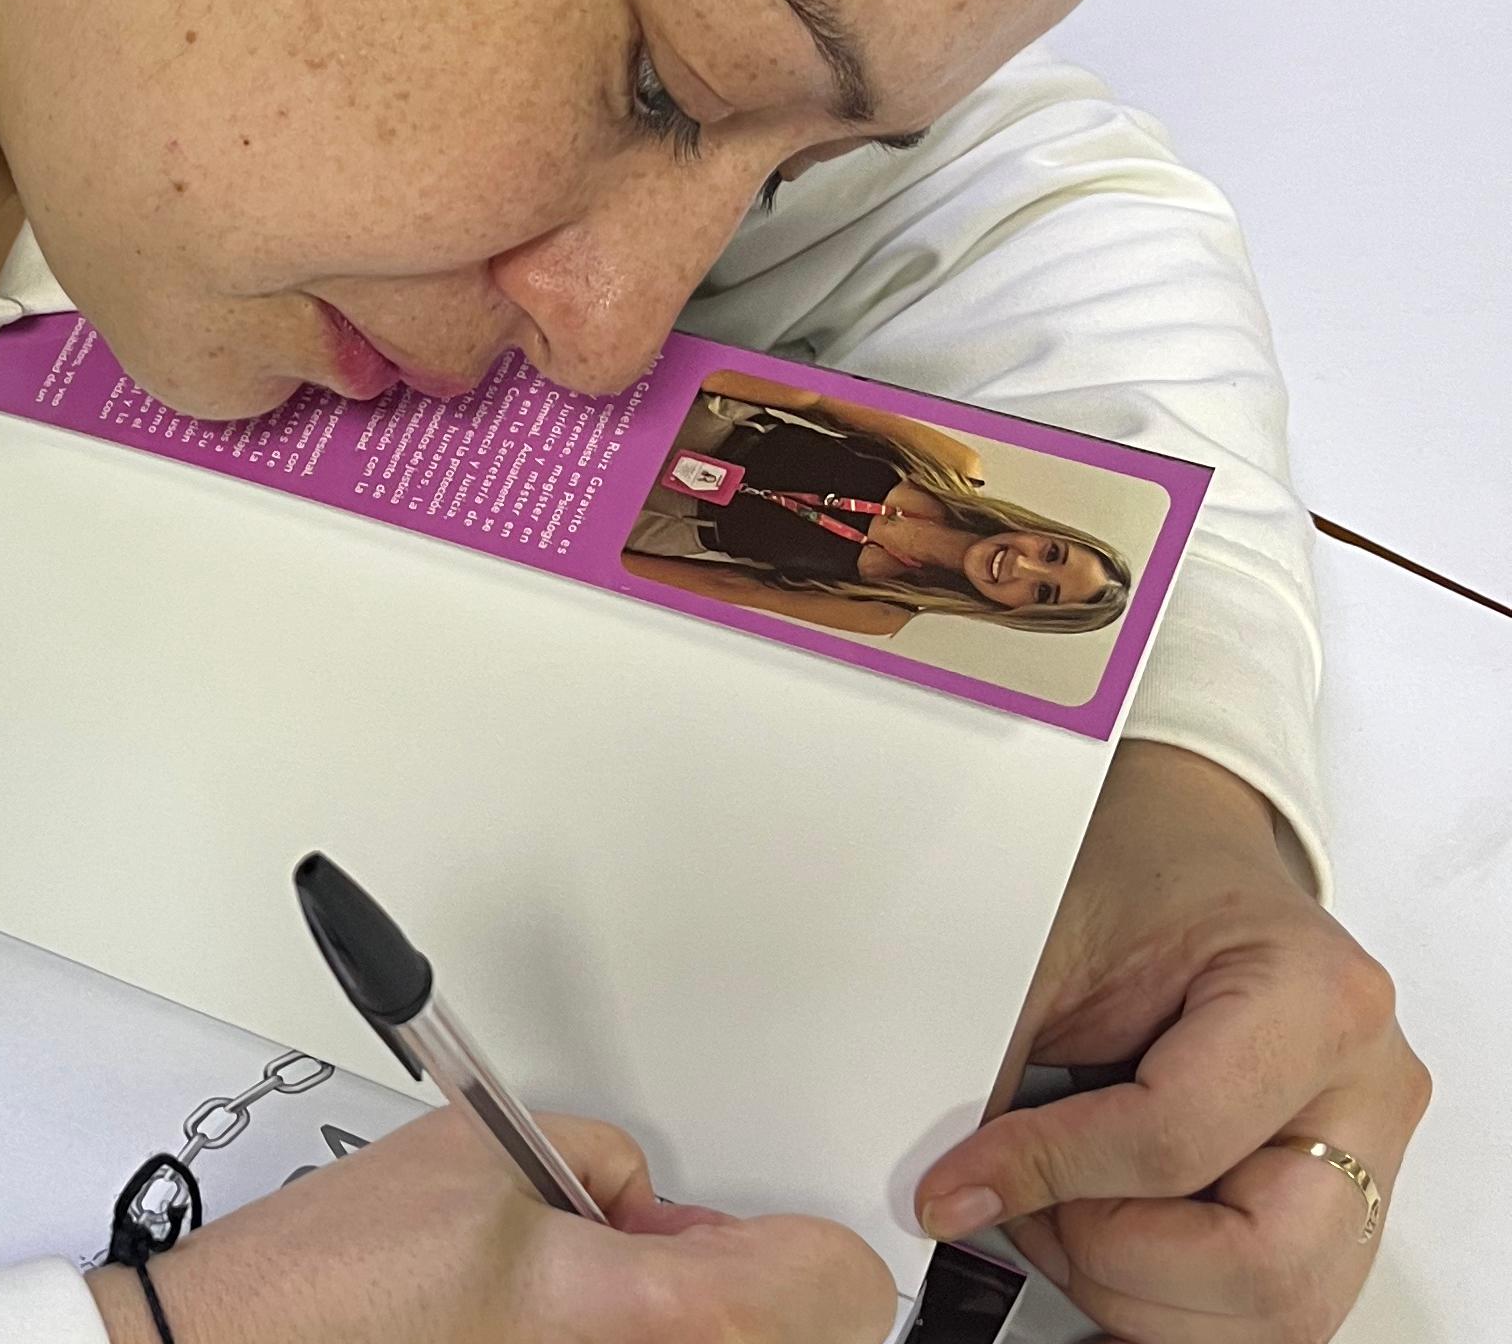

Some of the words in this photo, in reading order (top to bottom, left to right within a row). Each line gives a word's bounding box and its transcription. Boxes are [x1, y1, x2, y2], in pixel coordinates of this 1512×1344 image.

[52, 317, 87, 373] posibilidad
[43, 373, 57, 388] de
[63, 371, 75, 385] yo
[35, 388, 48, 402] un
[110, 377, 128, 399] vida
[485, 385, 499, 399] su
[51, 387, 67, 407] veo
[123, 399, 133, 408] y
[99, 399, 114, 420] con
[471, 400, 493, 430] labor
[518, 400, 532, 416] en
[614, 382, 650, 436] Gabriela
[115, 412, 129, 424] la
[131, 417, 142, 429] el
[148, 406, 167, 434] omo
[477, 387, 520, 455] Convivencia
[164, 418, 180, 438] uso
[296, 408, 323, 449] cercana
[417, 404, 446, 450] modelos
[509, 421, 525, 433] la
[578, 403, 615, 467] especialista
[198, 431, 214, 448] Su
[258, 431, 271, 446] en
[383, 398, 432, 479] fortalecimiento
[461, 429, 475, 445] en
[249, 450, 264, 462] la
[266, 450, 281, 468] de
[409, 450, 424, 466] de
[455, 445, 470, 457] la
[597, 441, 621, 470] Ruiz
[284, 452, 299, 473] con
[363, 456, 379, 477] con
[469, 461, 481, 469] y
[534, 457, 546, 466] y
[474, 439, 515, 504] Secretaría
[491, 443, 533, 513] Actualmente
[568, 472, 581, 487] en
[354, 481, 369, 494] la
[372, 484, 386, 499] de
[390, 464, 418, 504] justicia
[426, 458, 461, 515] protección
[512, 471, 539, 516] máster
[408, 496, 424, 510] la
[568, 476, 603, 533] Garavito
[464, 510, 478, 527] de
[481, 518, 495, 532] se
[538, 491, 574, 549] Psicología
[500, 521, 514, 538] en
[519, 527, 533, 544] en
[557, 539, 571, 555] es
